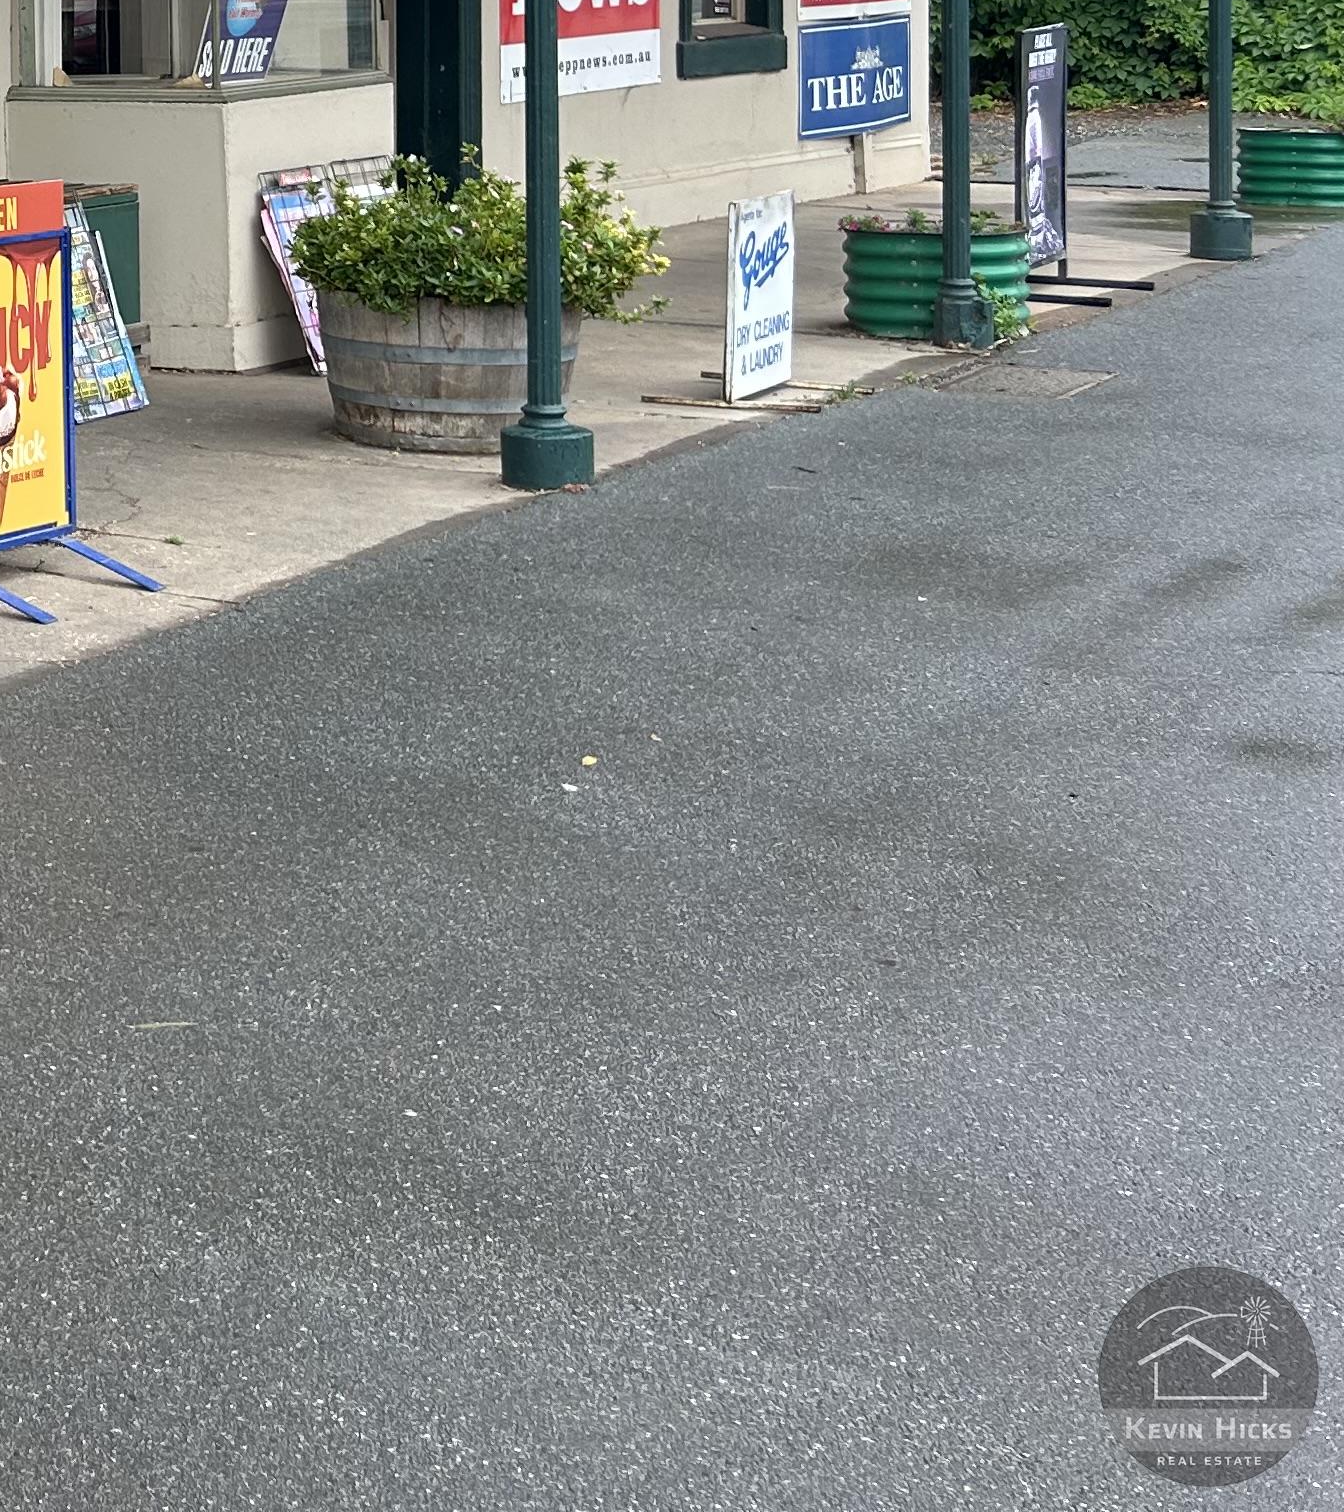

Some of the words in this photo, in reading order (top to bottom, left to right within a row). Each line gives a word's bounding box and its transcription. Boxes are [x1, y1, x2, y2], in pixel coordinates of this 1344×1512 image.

[231, 36, 273, 74] HERE
[808, 75, 867, 112] THE
[871, 65, 904, 105] AGE
[736, 321, 752, 348] DRY
[753, 310, 790, 339] CLEANING
[749, 341, 784, 373] LAUNDRY
